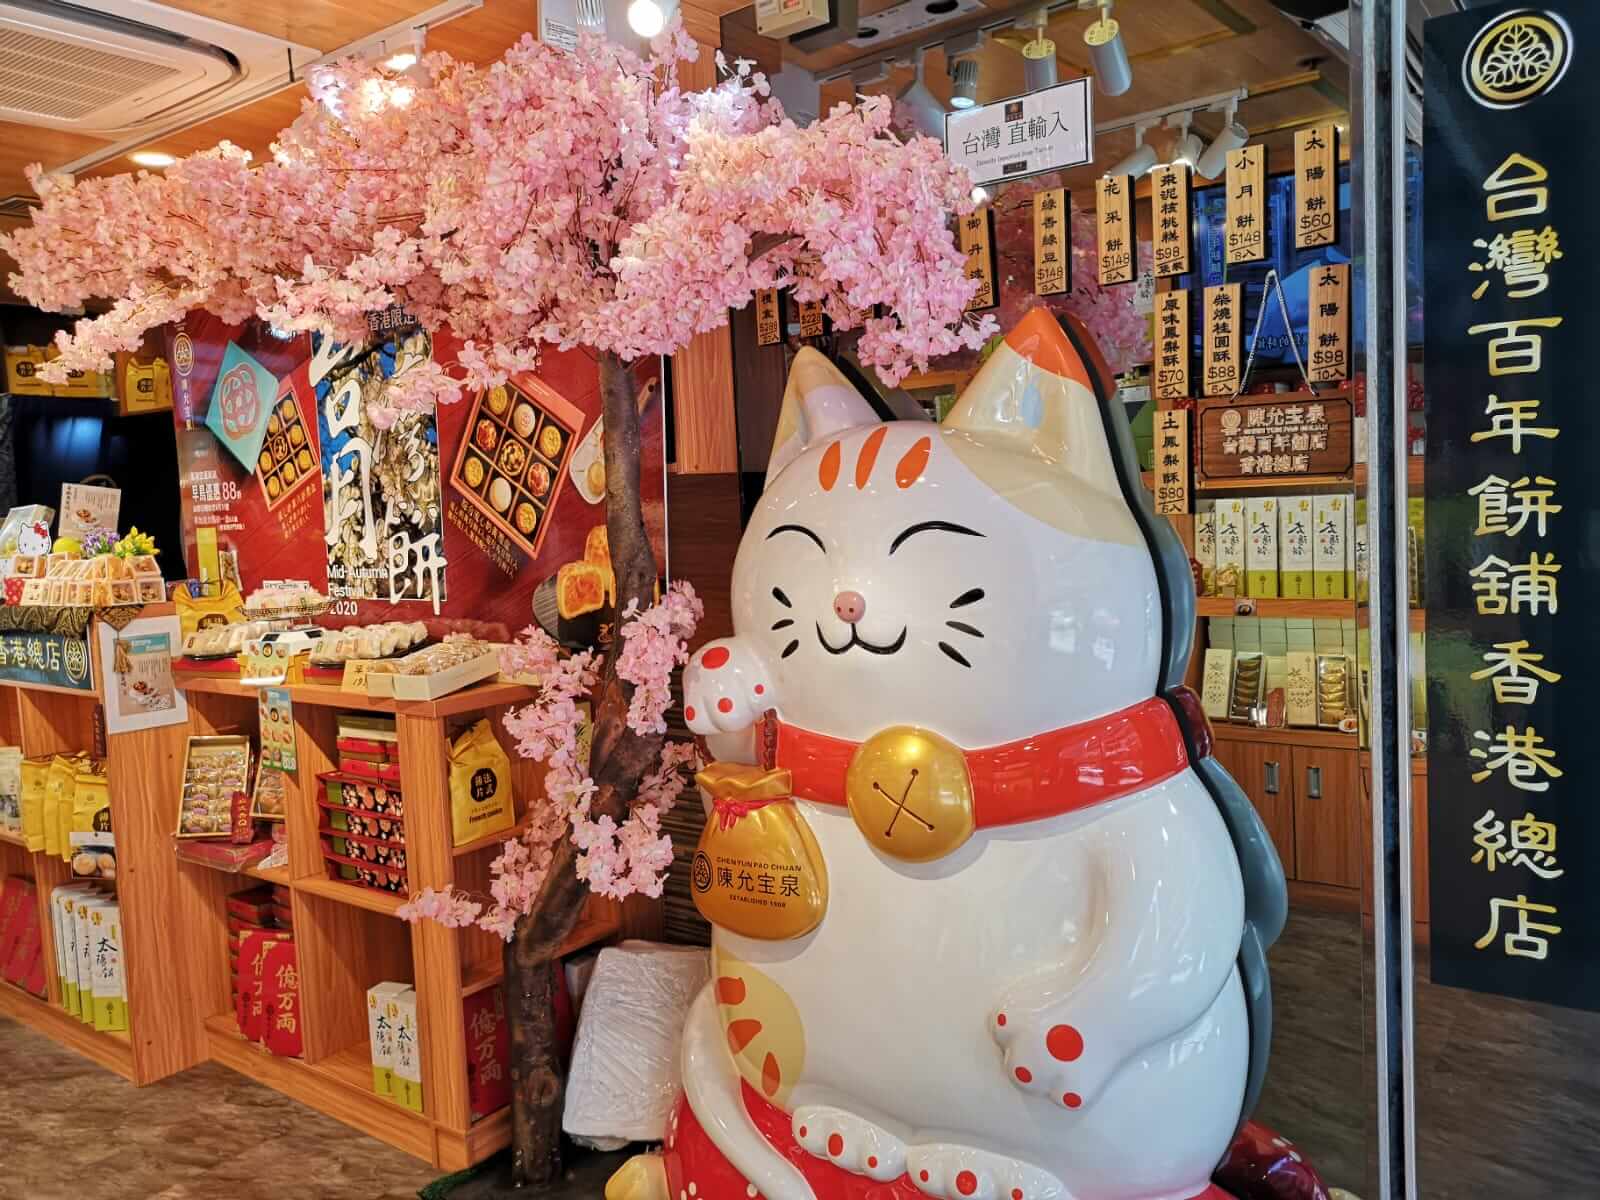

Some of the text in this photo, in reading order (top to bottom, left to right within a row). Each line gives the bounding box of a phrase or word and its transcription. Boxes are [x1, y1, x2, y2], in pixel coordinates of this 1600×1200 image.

[962, 111, 1069, 157] 台灣 直輸入
[1304, 136, 1326, 212] 太陽餅
[1235, 155, 1255, 229] 小月餅
[1300, 213, 1331, 230] $60
[1229, 230, 1261, 247] $148
[1102, 252, 1130, 269] $148
[1156, 246, 1180, 261] $98
[1037, 266, 1064, 281] $148
[1318, 272, 1341, 347] 太陽餅
[1162, 298, 1181, 367] 原味鳳梨酥
[1212, 293, 1232, 363] 柴燒桂圓酥
[1312, 350, 1345, 366] $98
[1158, 368, 1185, 385] $70
[1207, 365, 1236, 380] $88
[1161, 418, 1180, 486] 土鳳梨酥
[1158, 487, 1185, 500] $80
[1467, 152, 1564, 962] 台灣百年餅舖香港總店
[330, 601, 358, 616] 2020
[717, 866, 801, 897] 陳允宝泉
